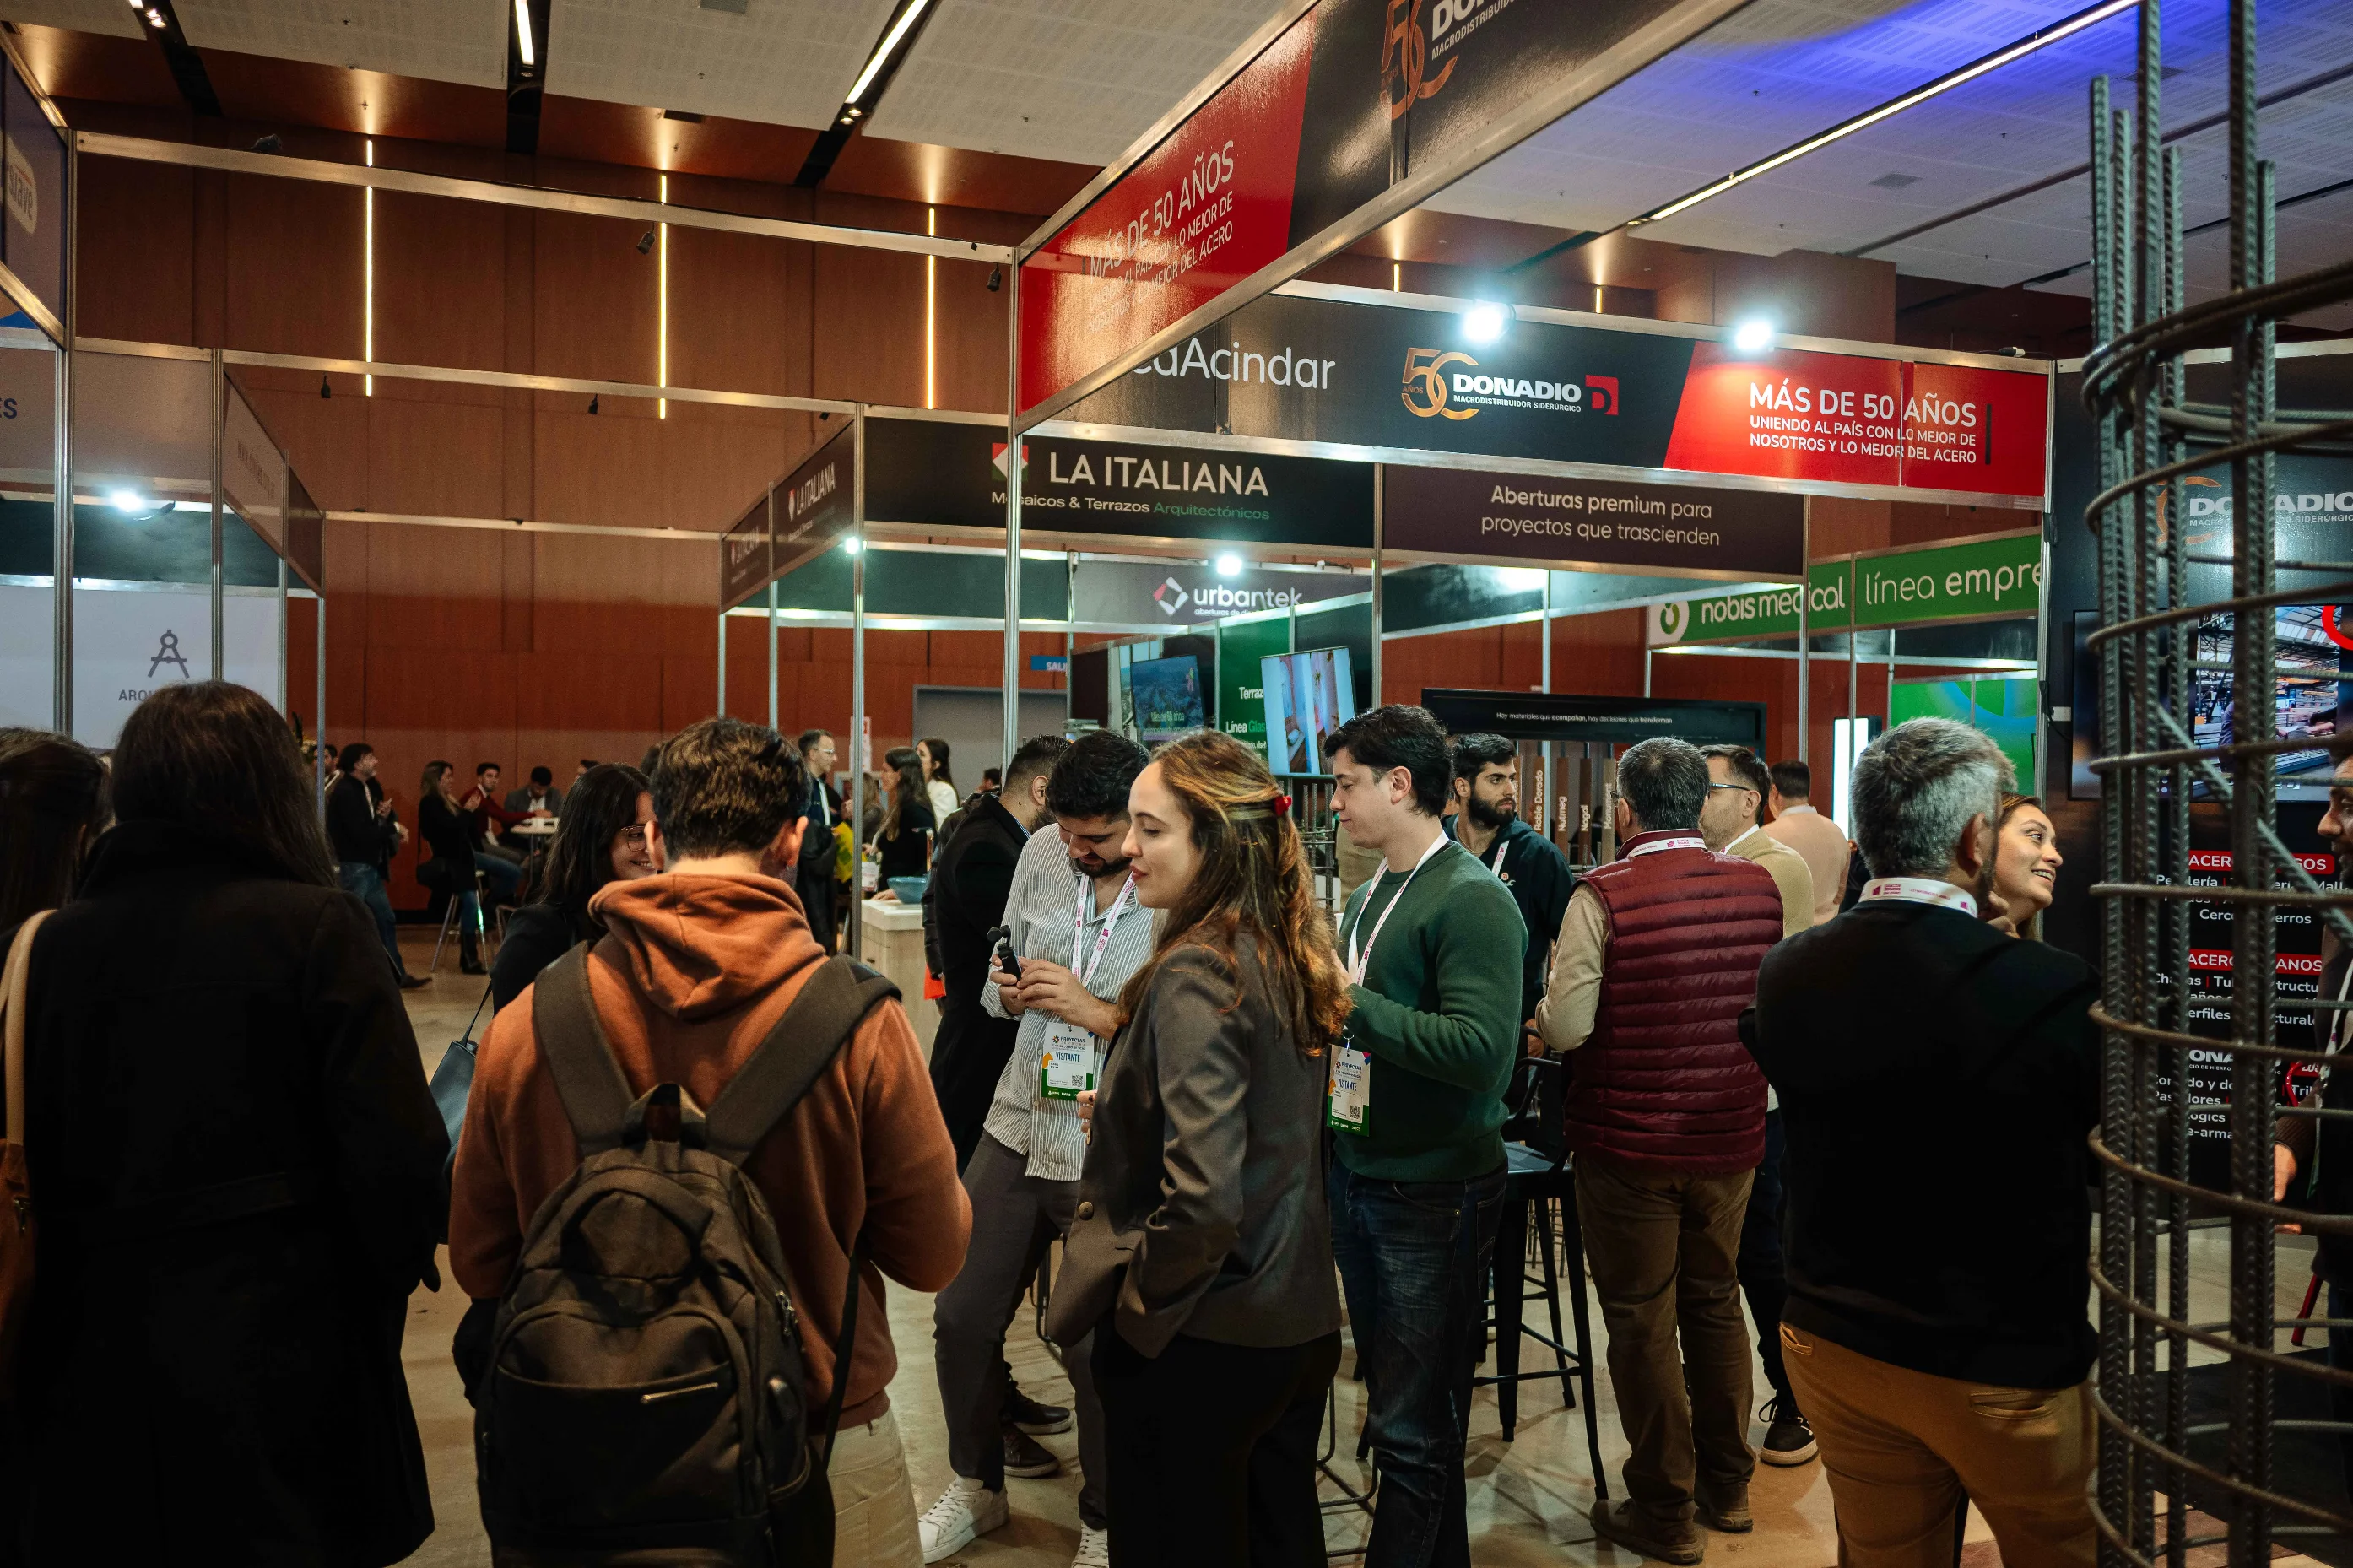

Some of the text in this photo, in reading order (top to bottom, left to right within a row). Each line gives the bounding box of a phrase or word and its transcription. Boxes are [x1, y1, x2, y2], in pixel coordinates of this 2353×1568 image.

[1432, 0, 1516, 61] MACRODISTRIBUID
[1128, 209, 1149, 257] DE
[1154, 190, 1174, 237] 50
[1178, 140, 1234, 219] AÑOS
[1174, 228, 1186, 251] LO
[1187, 203, 1218, 241] MEJOR
[1220, 191, 1233, 217] DE
[1180, 248, 1198, 274] DEL
[1199, 220, 1233, 262] ACERO
[1402, 386, 1424, 394] AÑOS
[1452, 373, 1582, 403] DONADIO
[1453, 394, 1582, 413] MACRODISTRIBUIDOR SIDERÚRGICO
[1750, 377, 1977, 427] MÁS DE 50 AÑOS
[1750, 414, 1976, 446] UNIENDO AL PAÍS CON LO MEJOR DE
[1750, 433, 1977, 464] NOSOTROS Y LO MEJOR DEL ACERO
[1050, 451, 1269, 496] LA ITALIANA
[1068, 496, 1081, 508] &
[1085, 497, 1150, 513] Terrazos
[1153, 501, 1270, 521] Arquitectónicos
[1490, 485, 1712, 520] Aberturas premium para
[1481, 516, 1720, 546] proyectos que trascienden
[1193, 584, 1302, 608] urbantek
[1866, 571, 1934, 605] línea
[1225, 720, 1247, 733] Línea
[1534, 770, 1544, 831] Roble Dorado
[1558, 796, 1568, 831] Nutmeg
[1581, 804, 1591, 831] Nogal
[2188, 1008, 2231, 1020] erfiles
[1056, 1052, 1080, 1062] VISITANTE
